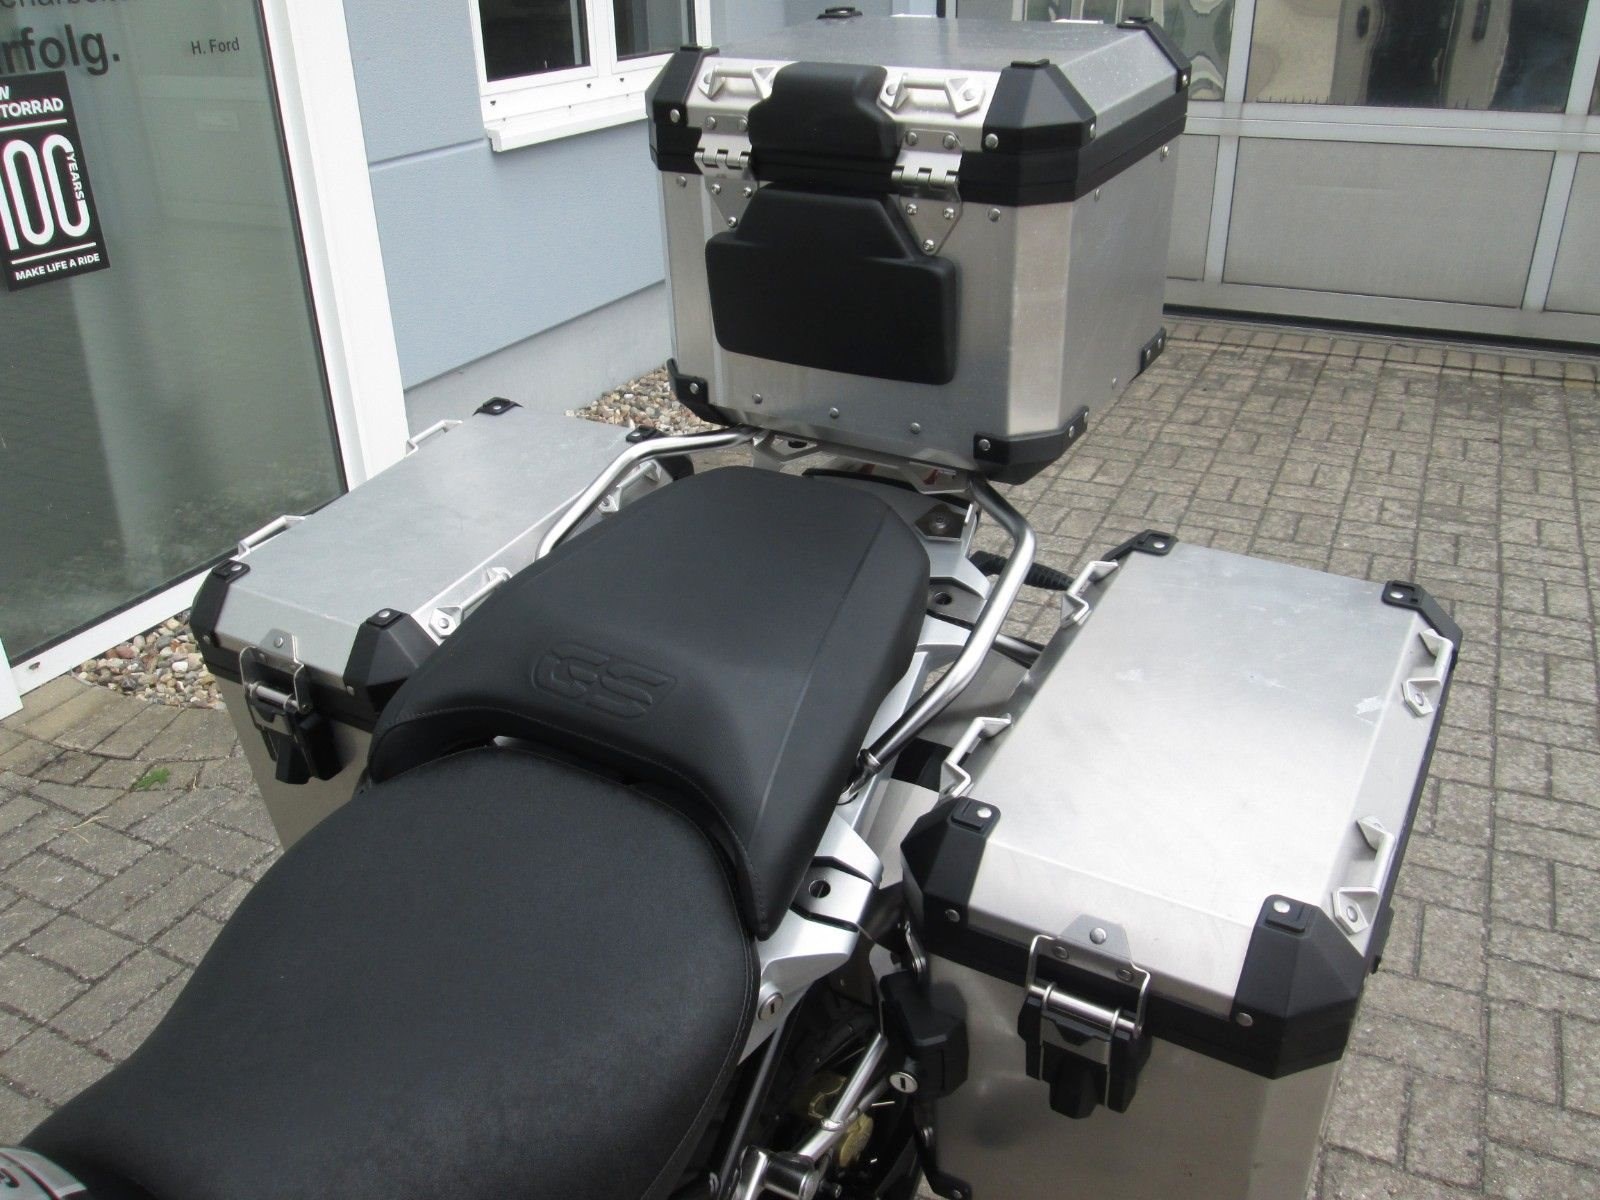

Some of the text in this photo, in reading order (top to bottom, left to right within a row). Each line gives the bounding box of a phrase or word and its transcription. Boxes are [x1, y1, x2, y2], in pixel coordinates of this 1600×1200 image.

[0, 24, 120, 76] rfolg.
[191, 36, 240, 55] H. Ford
[0, 97, 64, 118] TORRAD
[66, 152, 86, 200] YEARS
[15, 253, 100, 280] MAKE LIFE A RIDE
[532, 641, 679, 720] GS
